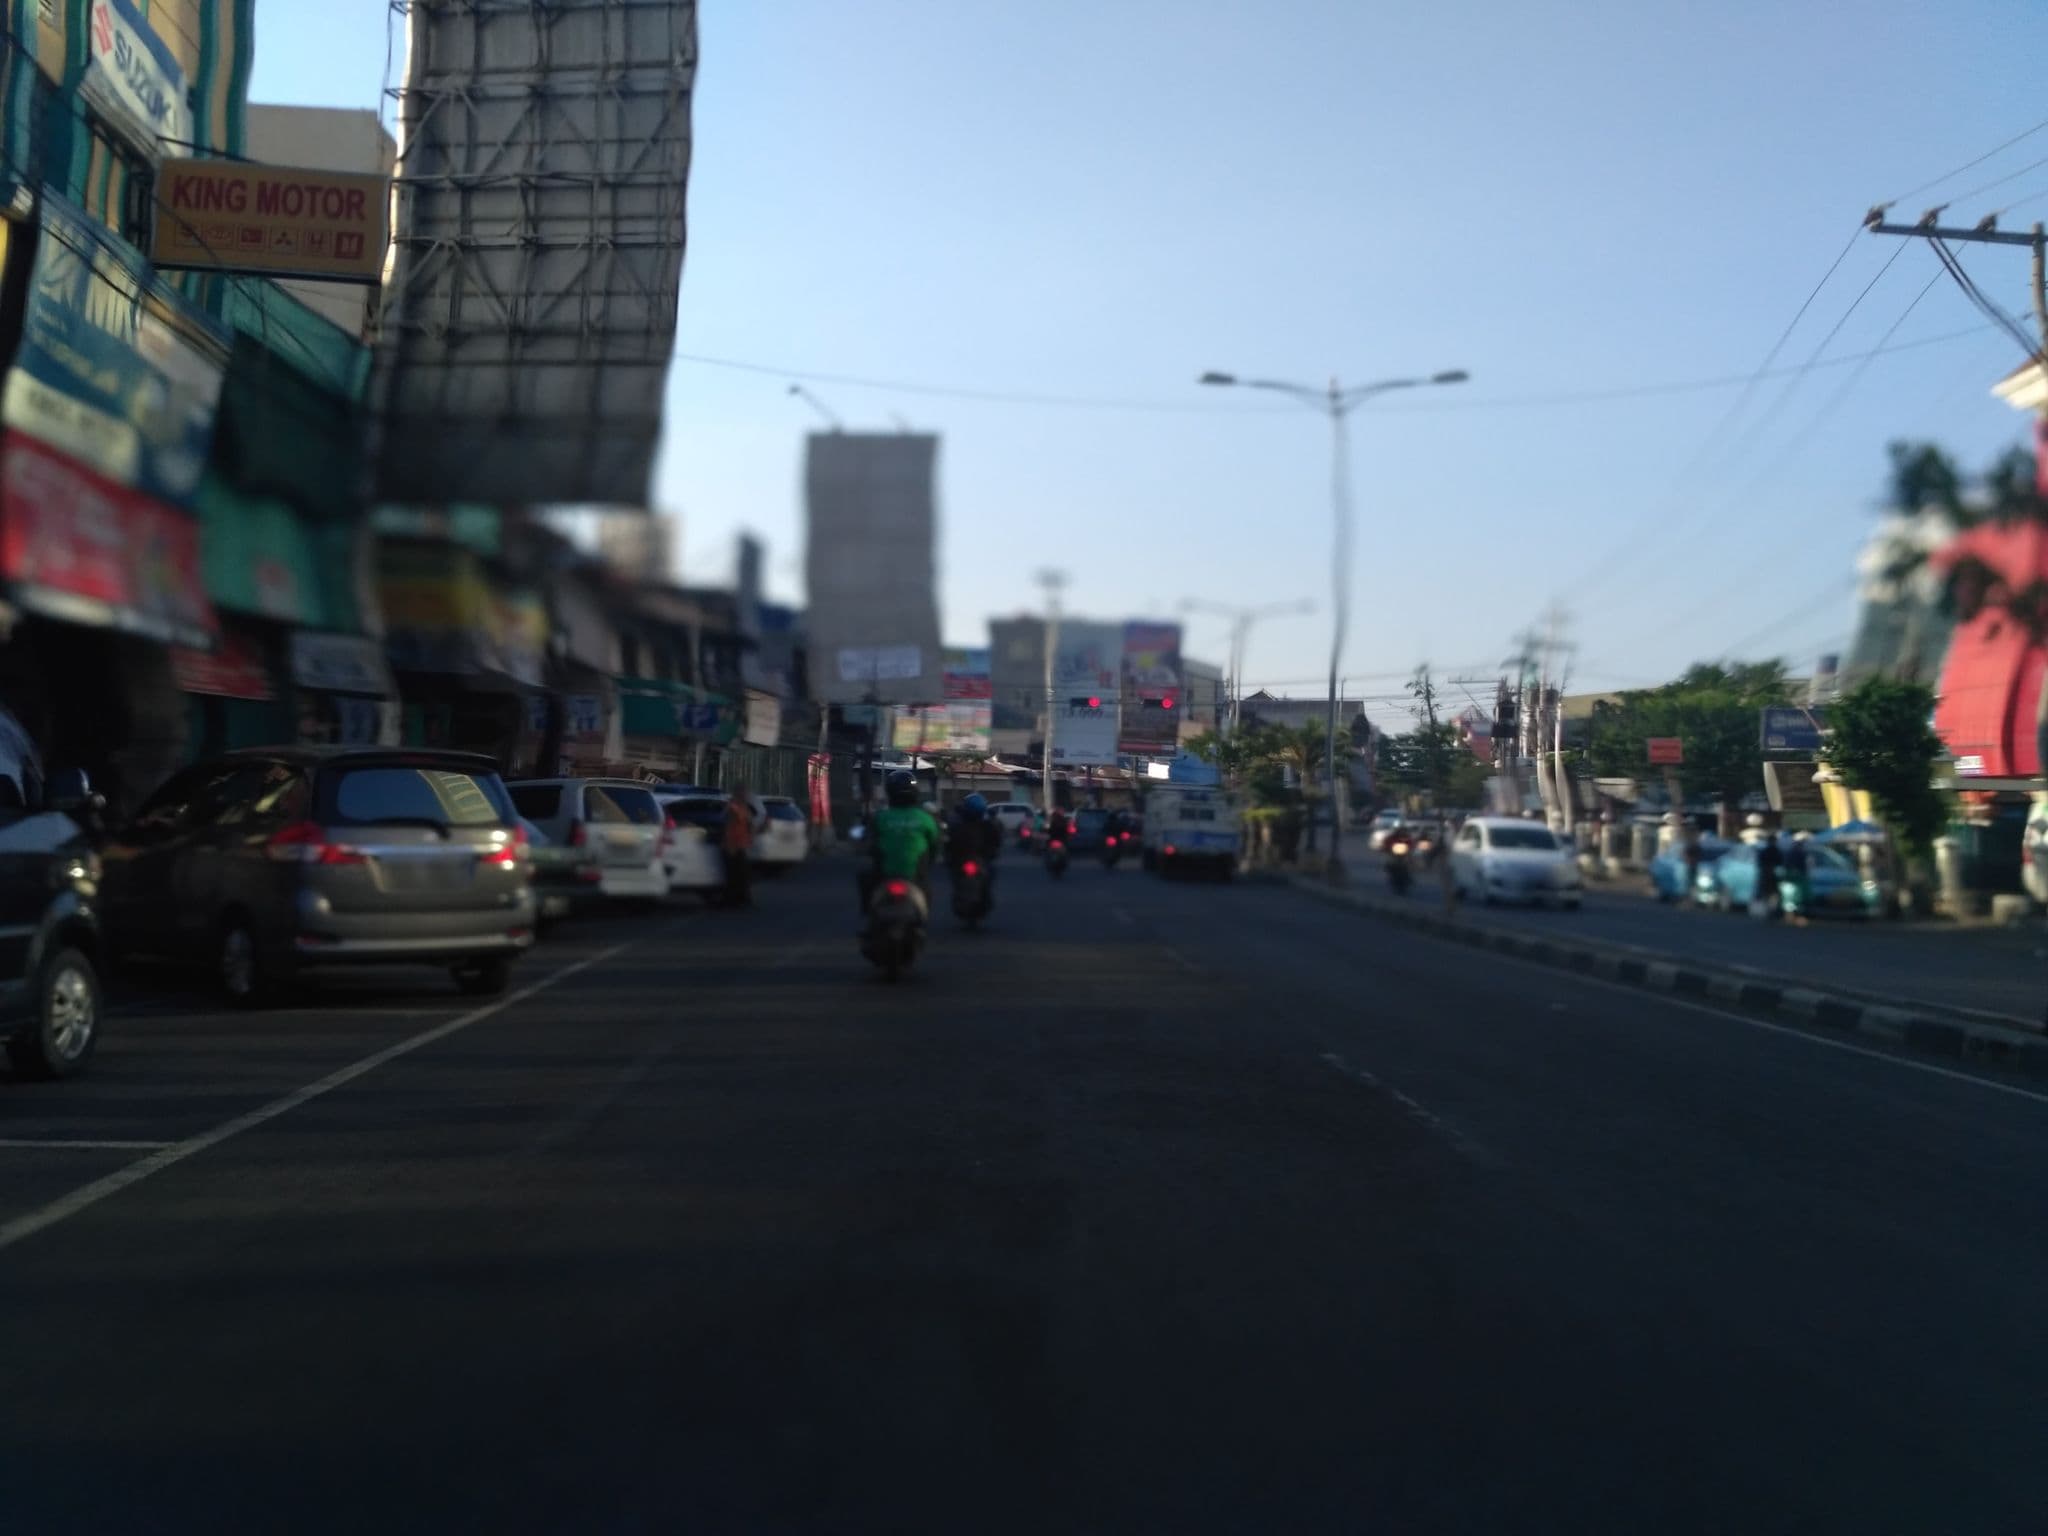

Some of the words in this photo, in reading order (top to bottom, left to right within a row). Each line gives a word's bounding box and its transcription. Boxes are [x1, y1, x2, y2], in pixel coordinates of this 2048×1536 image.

[113, 29, 180, 136] SUZUKI
[172, 174, 249, 213] KING
[256, 180, 367, 222] MOTOR
